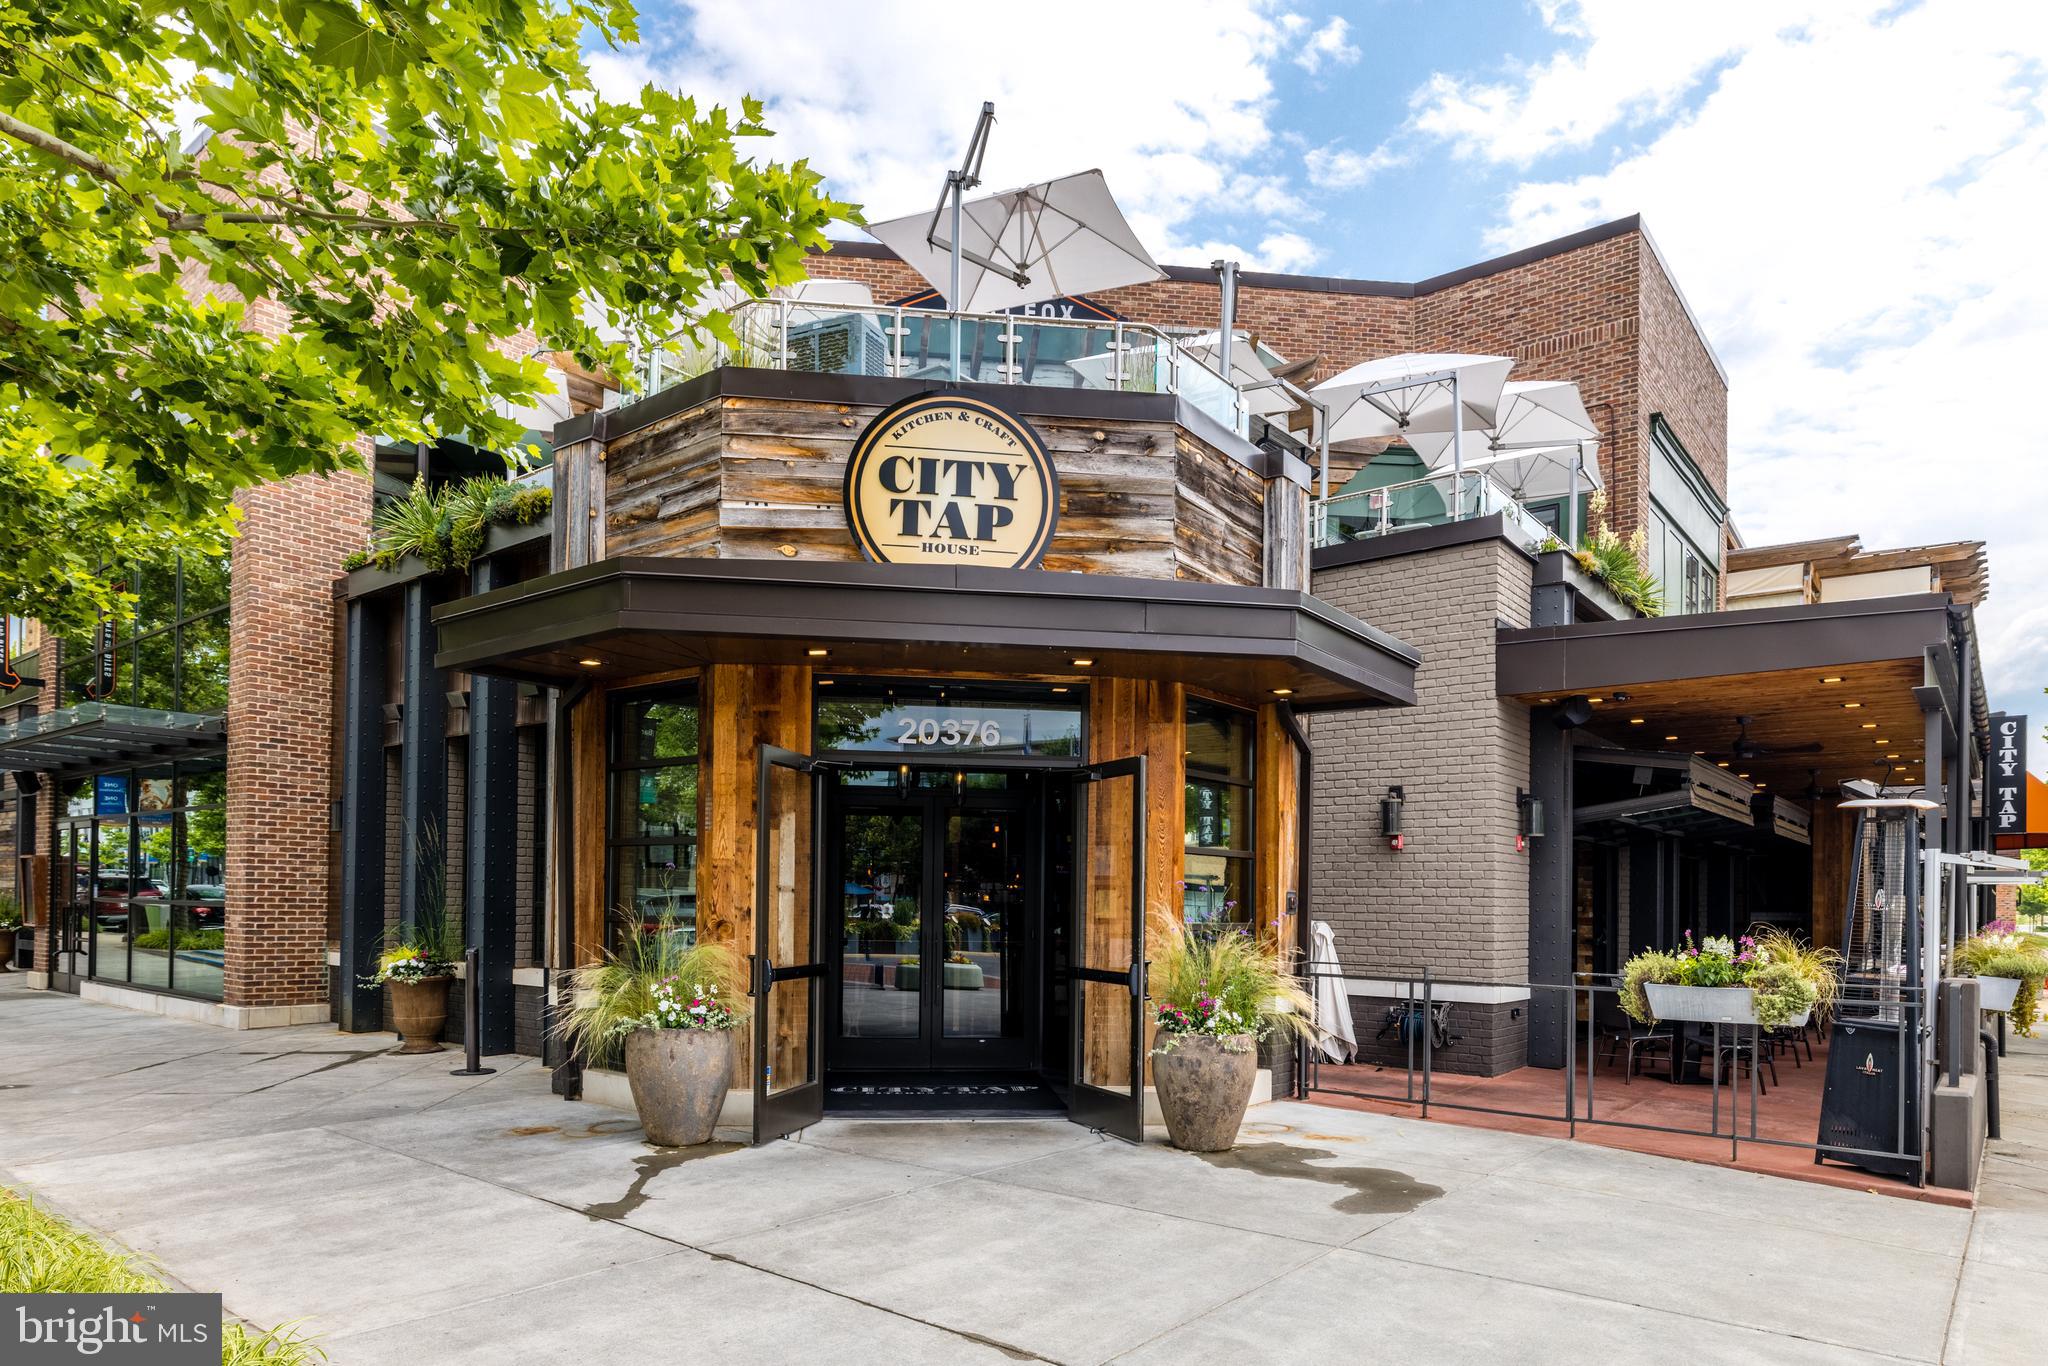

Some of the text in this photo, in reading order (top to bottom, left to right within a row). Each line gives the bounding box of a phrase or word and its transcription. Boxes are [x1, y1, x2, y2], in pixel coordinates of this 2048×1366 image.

[892, 411, 1017, 448] KITCHEN & CRAFT
[878, 455, 1028, 501] CITY
[889, 498, 1014, 542] TAP
[921, 542, 980, 556] HOUSE
[898, 718, 1001, 746] 20376
[1998, 721, 2018, 828] CITY TAP
